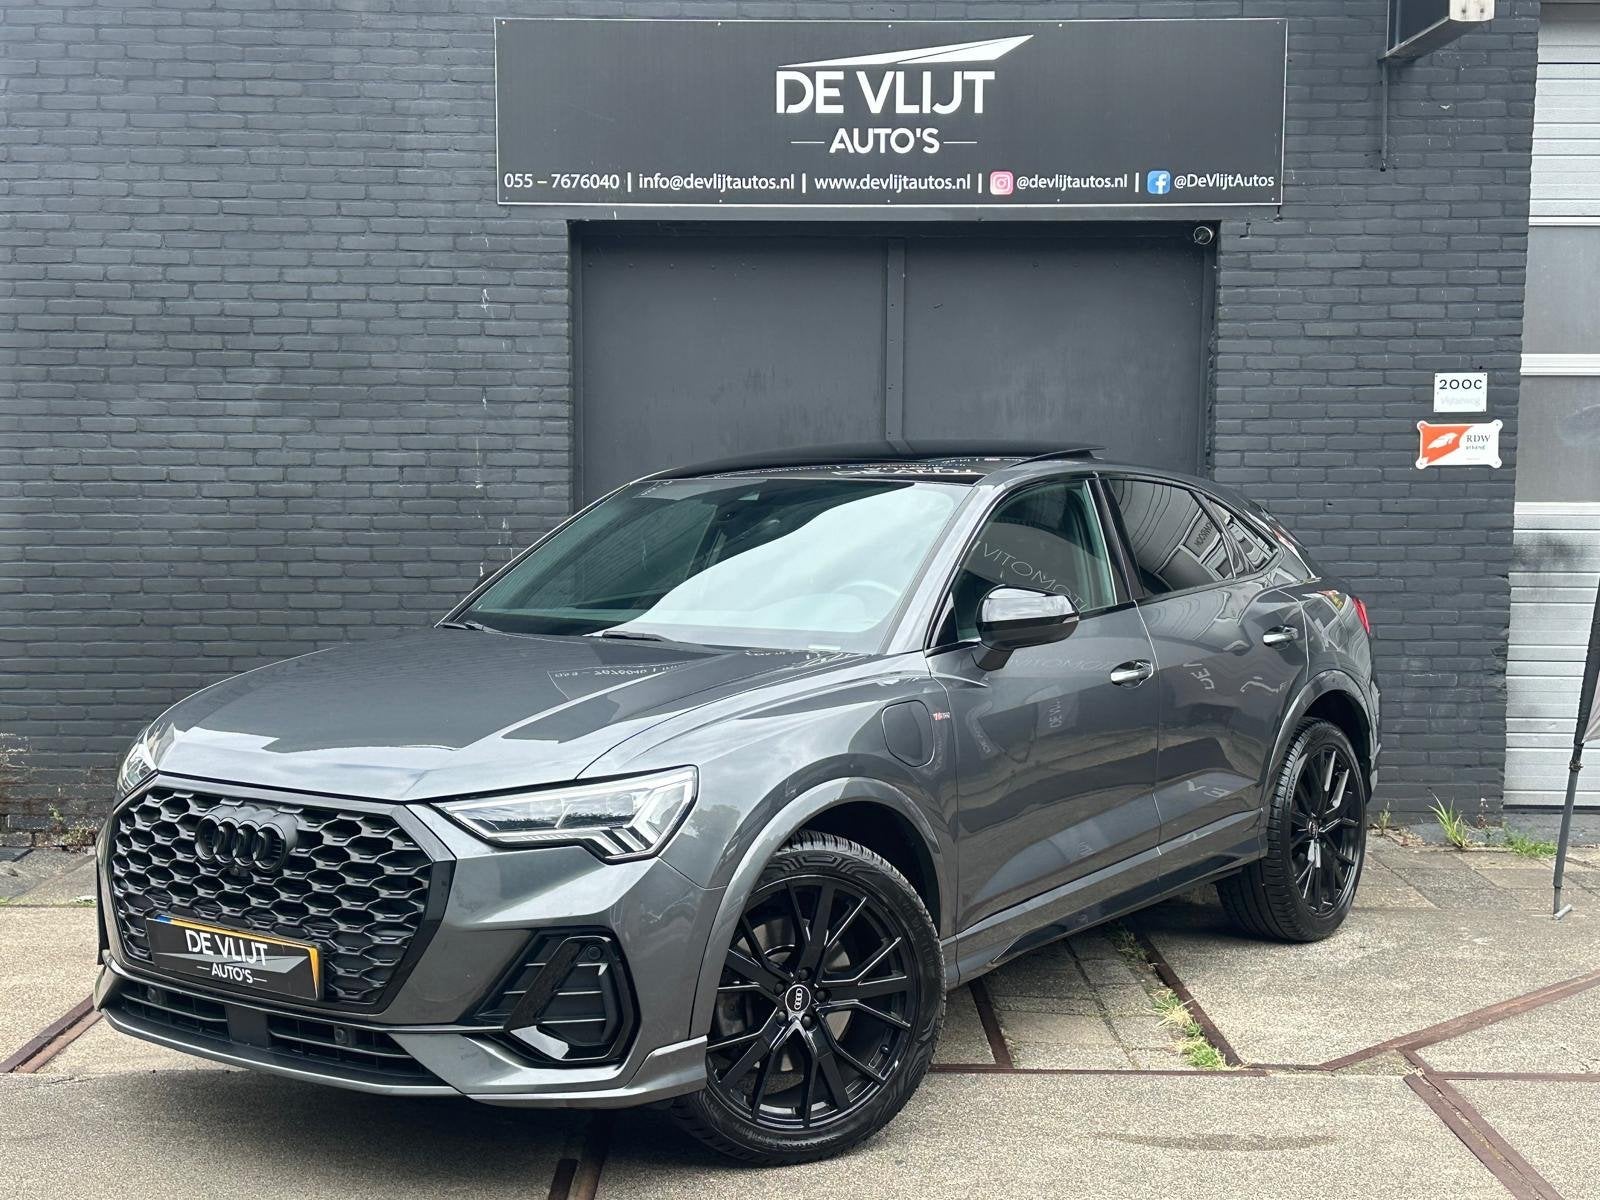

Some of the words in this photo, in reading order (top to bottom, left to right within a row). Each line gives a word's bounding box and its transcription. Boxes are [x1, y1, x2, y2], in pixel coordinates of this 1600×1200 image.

[775, 70, 845, 114] DE
[856, 70, 996, 115] VLIJT
[829, 127, 940, 155] AUTO'S
[503, 172, 534, 189] 055
[551, 173, 620, 190] 7676040
[638, 172, 795, 193] info@devlijtautos.nl
[814, 173, 971, 194] www.devlijtautos.nl
[1016, 173, 1128, 192] @devlijtautos.nl
[1174, 173, 1275, 191] @DeVlijtAutos
[1439, 379, 1483, 390] 200C
[1466, 434, 1491, 443] RDW
[185, 929, 211, 955] DE
[215, 934, 269, 966] VLIJT
[211, 962, 254, 984] AUTO'S
